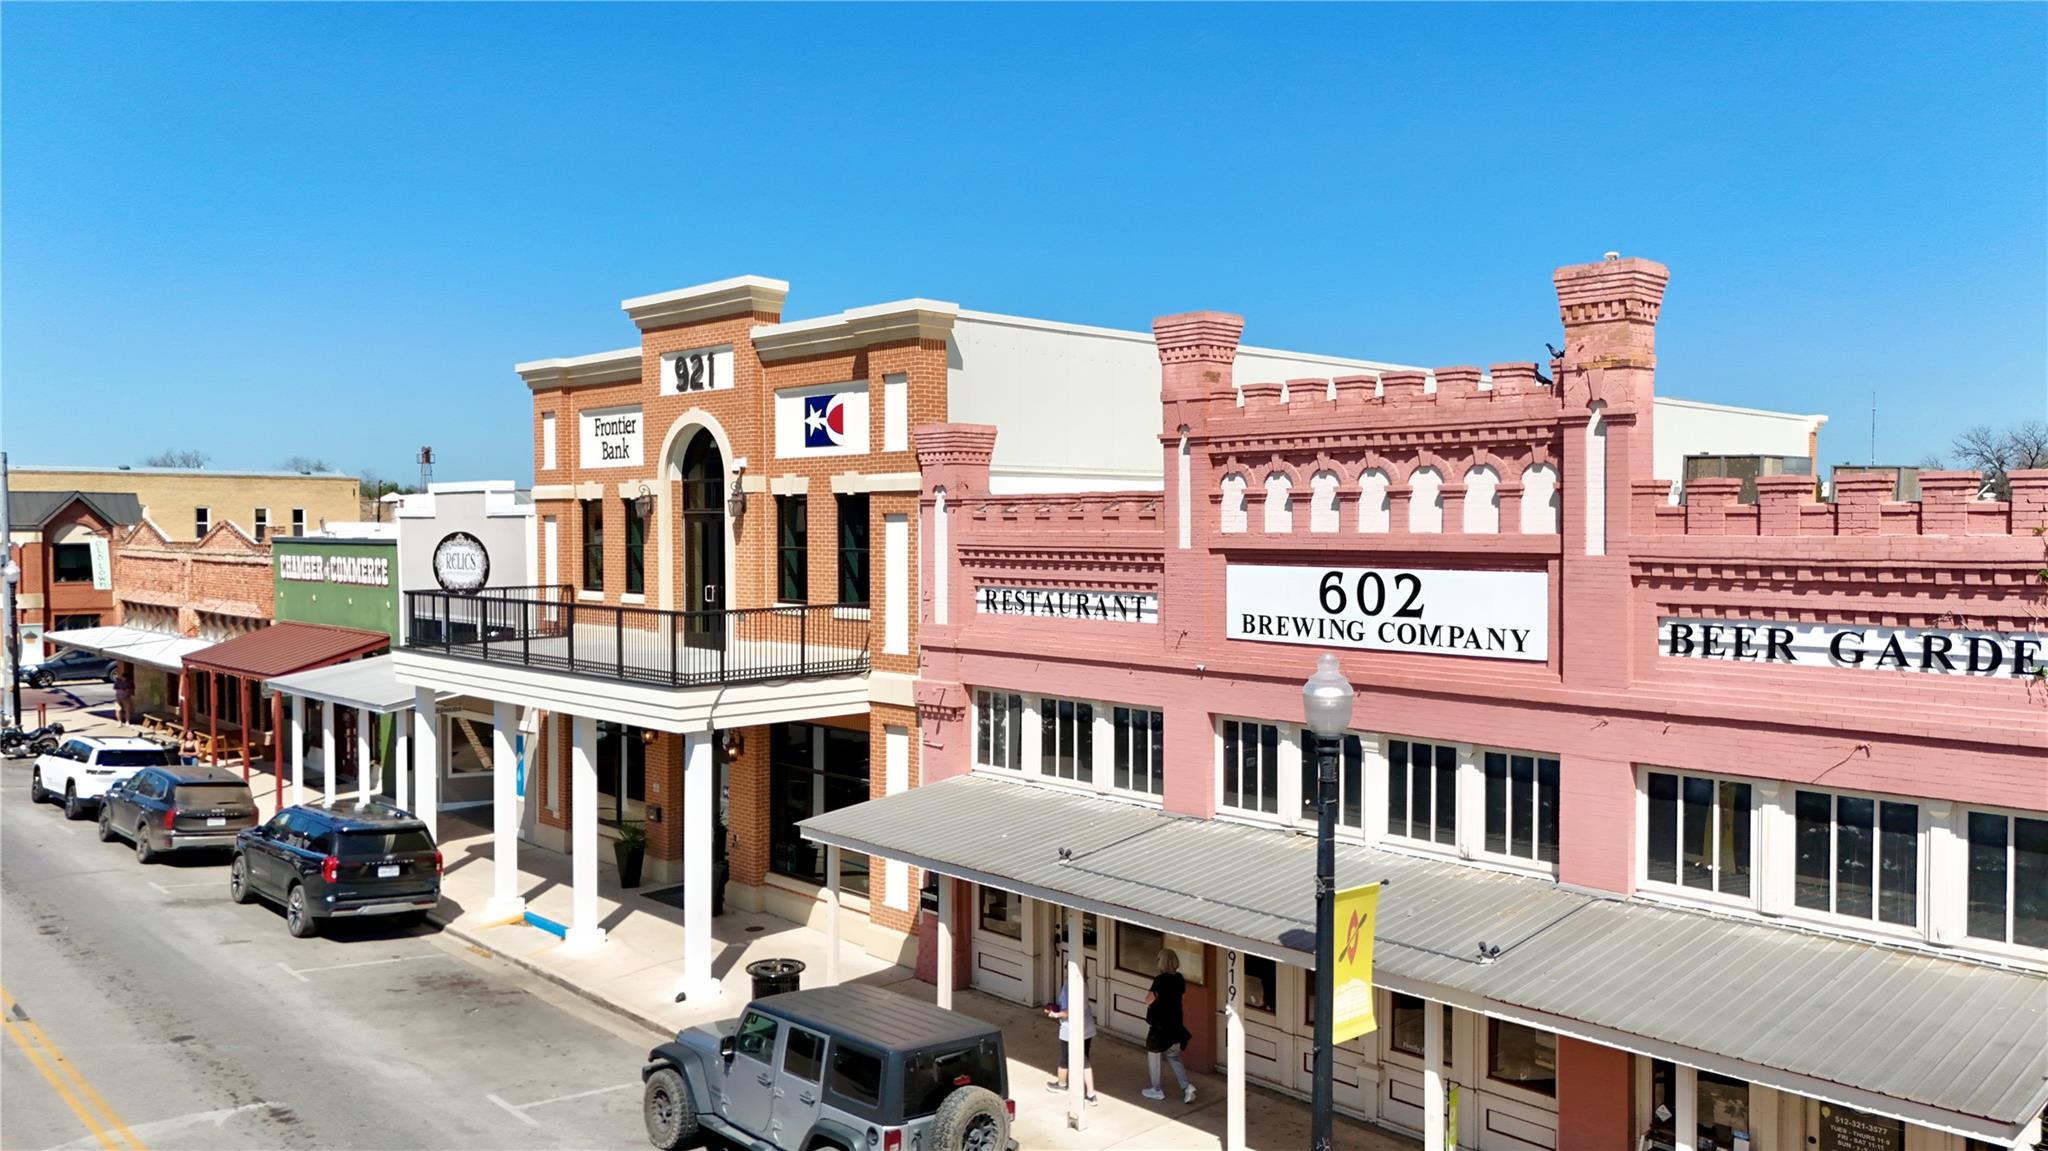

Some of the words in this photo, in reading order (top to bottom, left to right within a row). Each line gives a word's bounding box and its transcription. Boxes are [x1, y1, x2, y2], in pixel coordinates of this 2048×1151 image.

[674, 351, 715, 392] 921
[594, 416, 637, 436] Frontier
[601, 437, 630, 460] Bank
[280, 555, 324, 580] CHAMBER
[330, 556, 389, 586] COMMERCE
[446, 552, 476, 570] RELICS
[985, 589, 1147, 620] RESTAURANT
[1319, 570, 1425, 619] 602
[1241, 613, 1366, 642] BREWING
[1377, 621, 1531, 652] COMPANY
[1667, 624, 1798, 661] BEER
[1228, 951, 1236, 1001] 919
[1835, 1116, 1888, 1135] 512-321-3577
[1853, 1131, 1876, 1142] THURS
[1853, 1138, 1867, 1146] SAT
